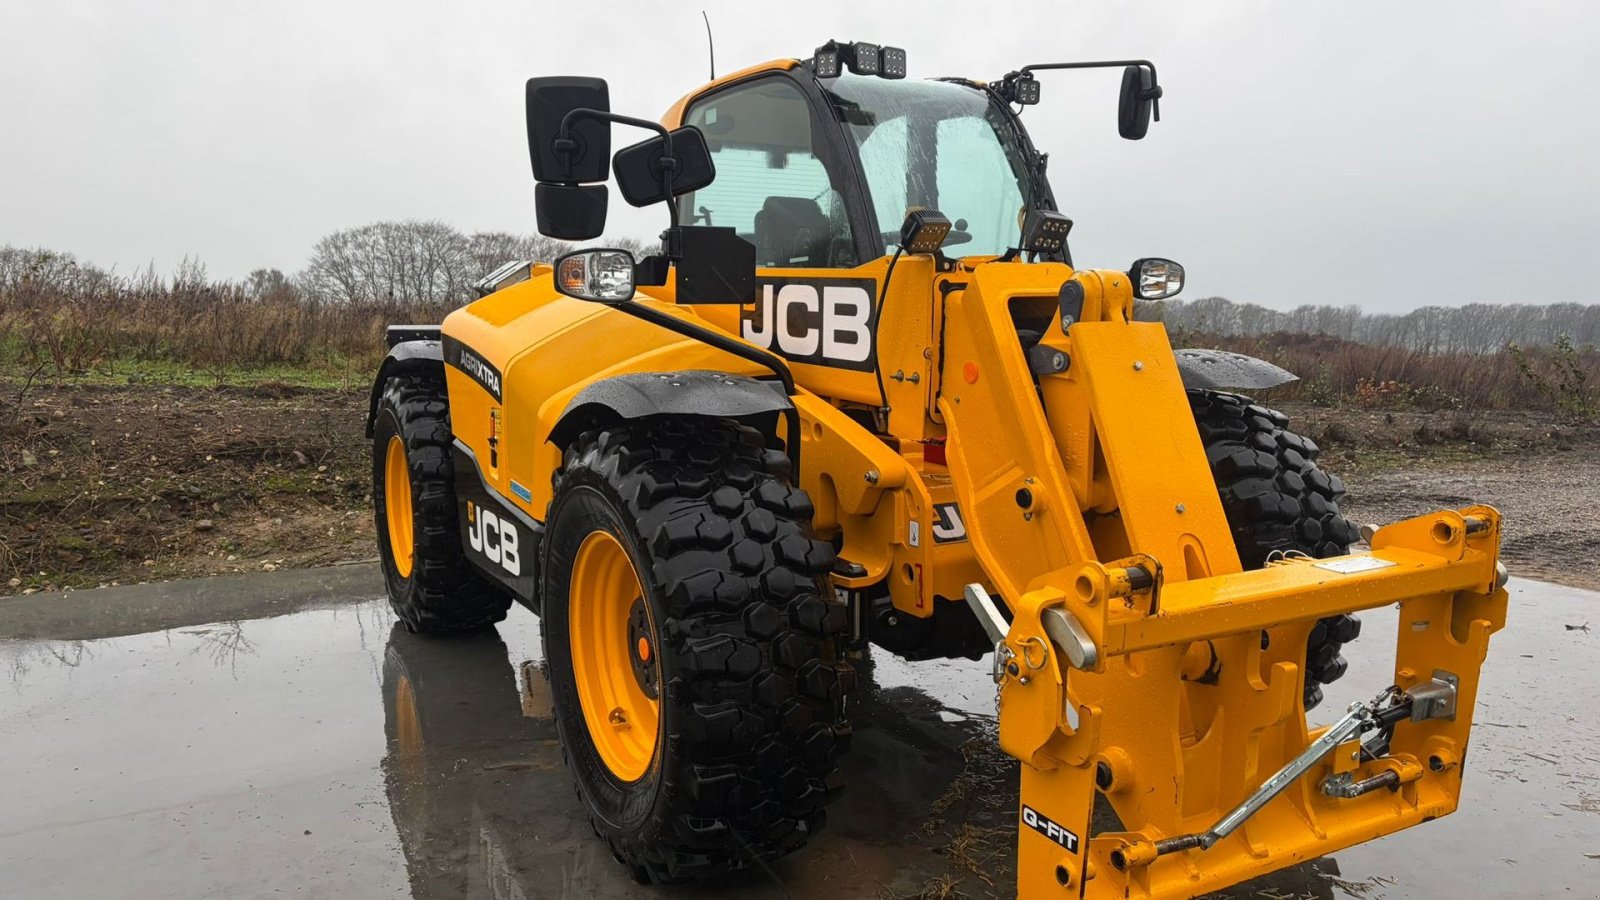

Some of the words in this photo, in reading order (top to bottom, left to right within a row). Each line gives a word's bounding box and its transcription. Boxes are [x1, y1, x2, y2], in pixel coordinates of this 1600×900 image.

[743, 284, 871, 362] JCB
[461, 349, 500, 396] AGRIXTRA
[469, 505, 520, 576] JCB
[1023, 807, 1077, 849] Q-FIT
